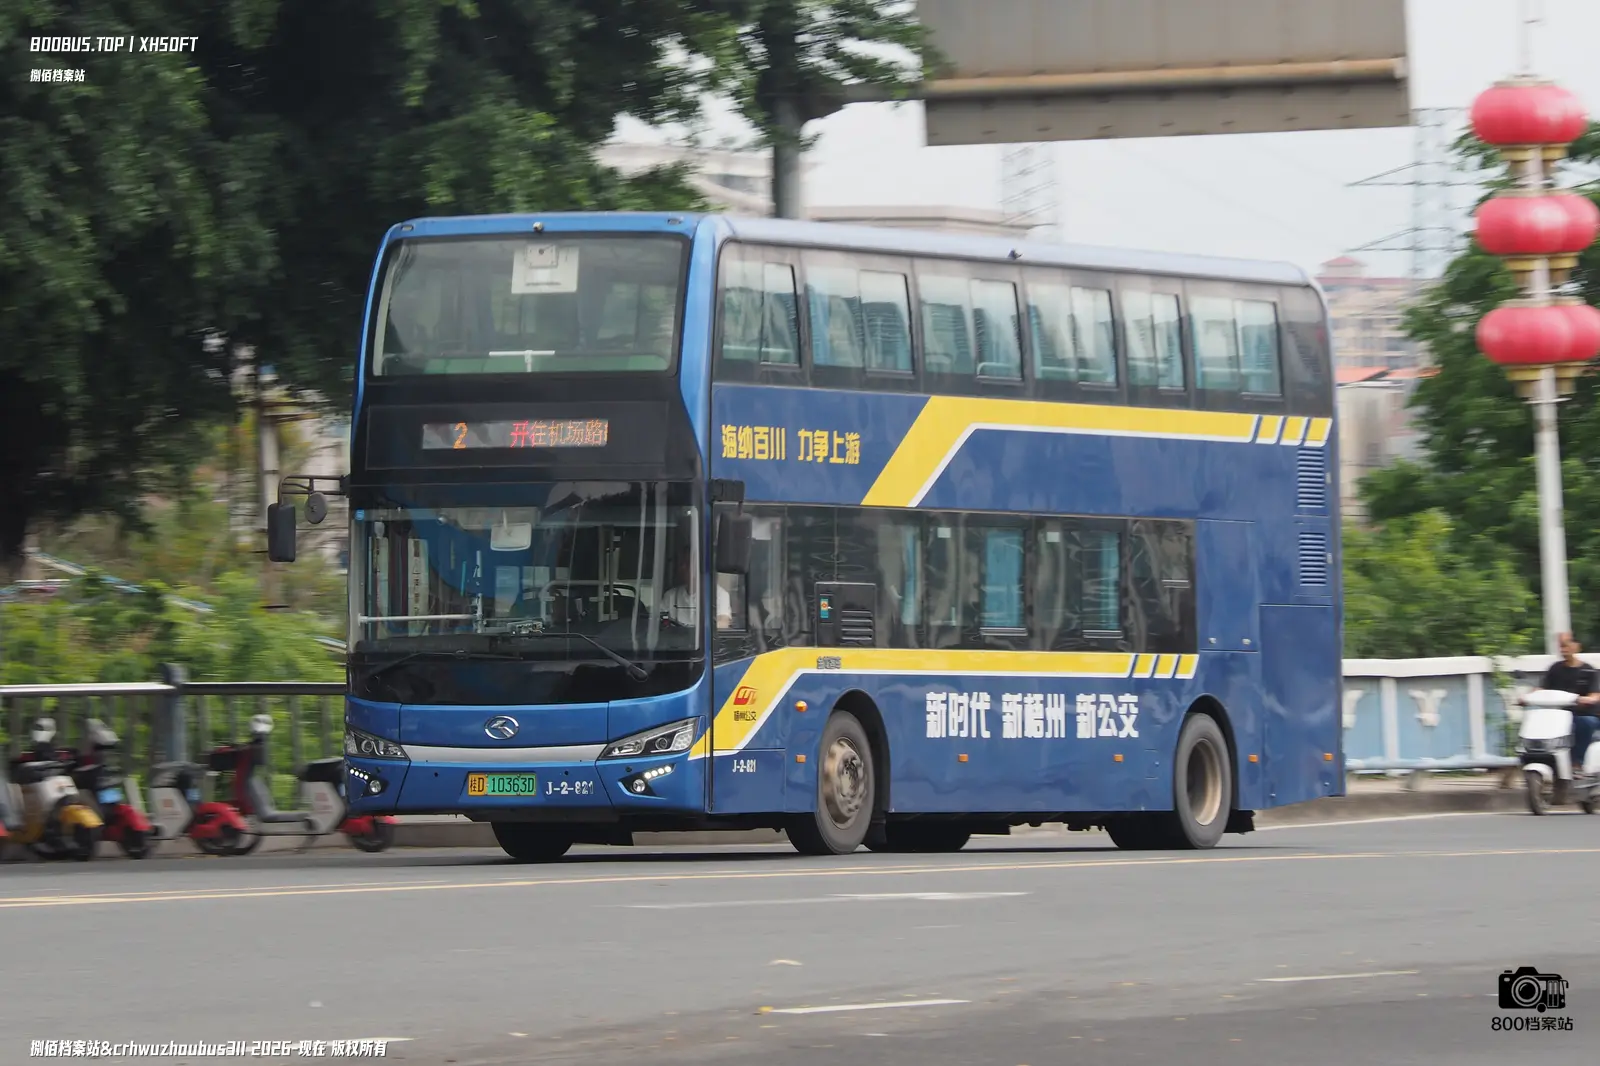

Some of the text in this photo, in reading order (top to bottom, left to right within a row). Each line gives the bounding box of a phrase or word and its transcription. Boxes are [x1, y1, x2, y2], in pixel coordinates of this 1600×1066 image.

[453, 422, 468, 449] 2
[721, 424, 860, 464] 海纳百川 力争上游
[926, 691, 1139, 738] 新时代 新梧州 新公交
